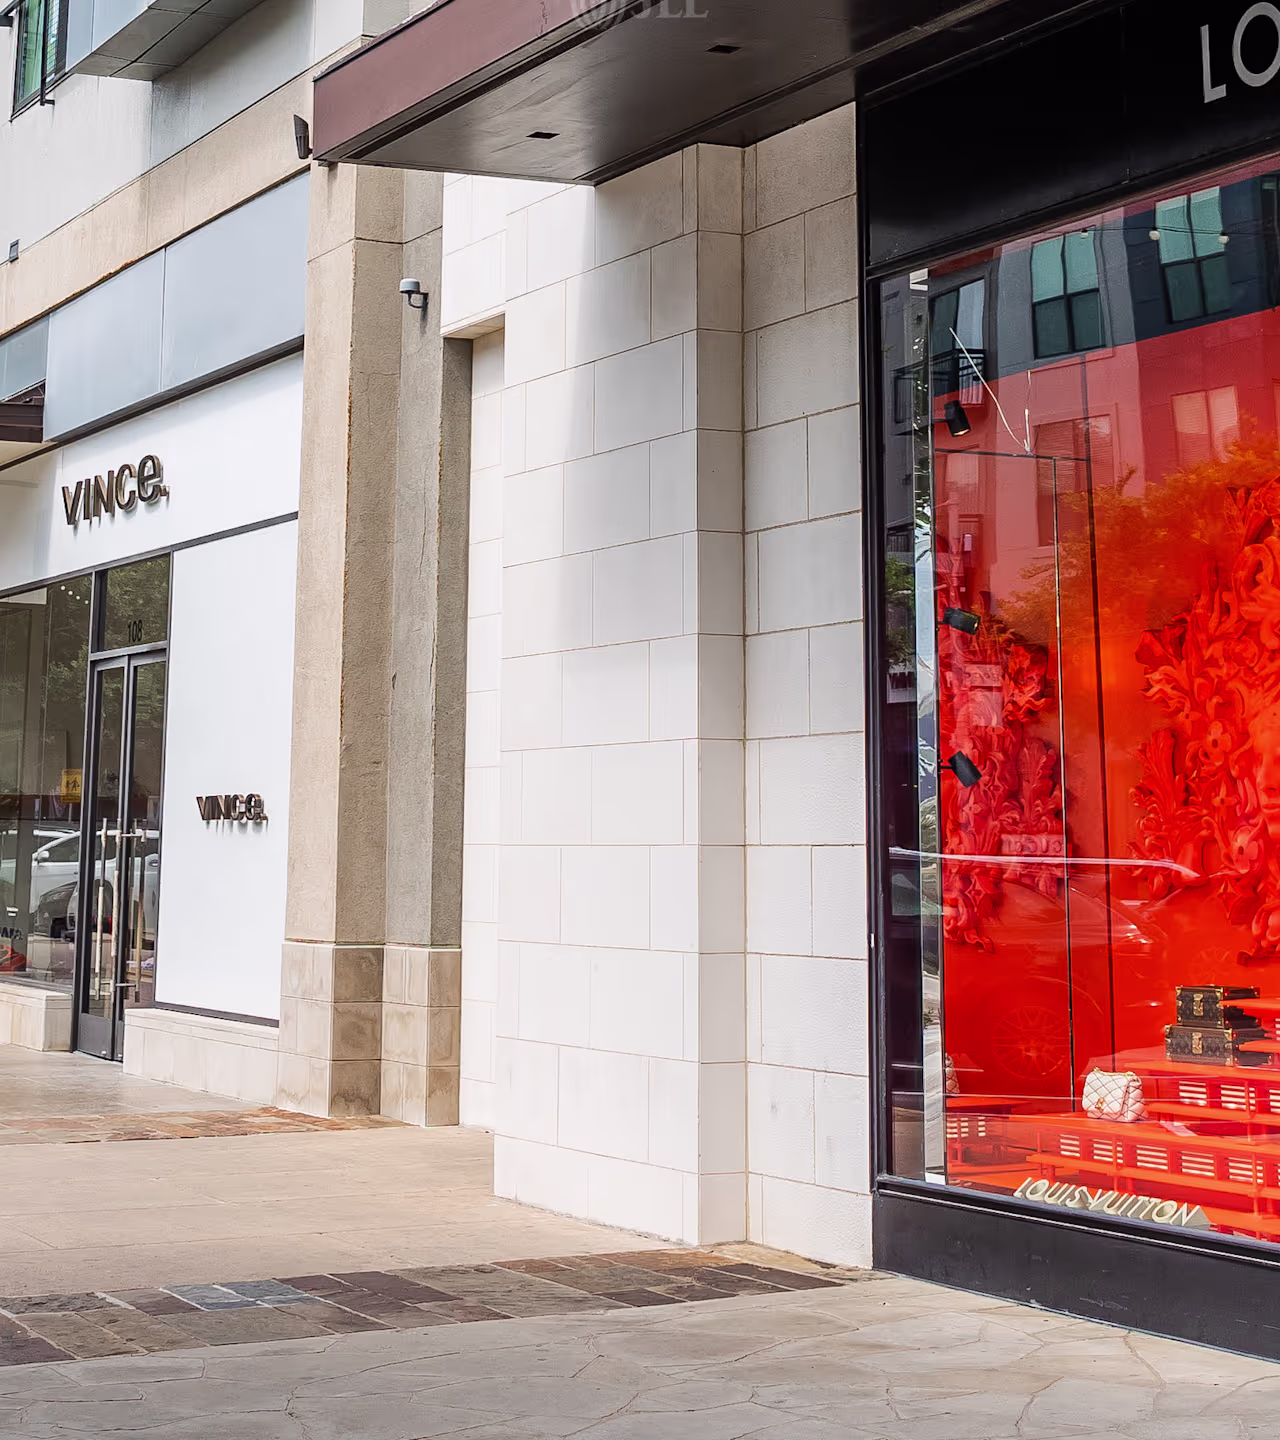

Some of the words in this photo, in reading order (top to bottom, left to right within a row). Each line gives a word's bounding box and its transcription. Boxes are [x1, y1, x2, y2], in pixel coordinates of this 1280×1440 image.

[127, 619, 143, 643] 108
[1013, 1177, 1091, 1208] LOUIS
[1087, 1188, 1203, 1227] VUITTON
